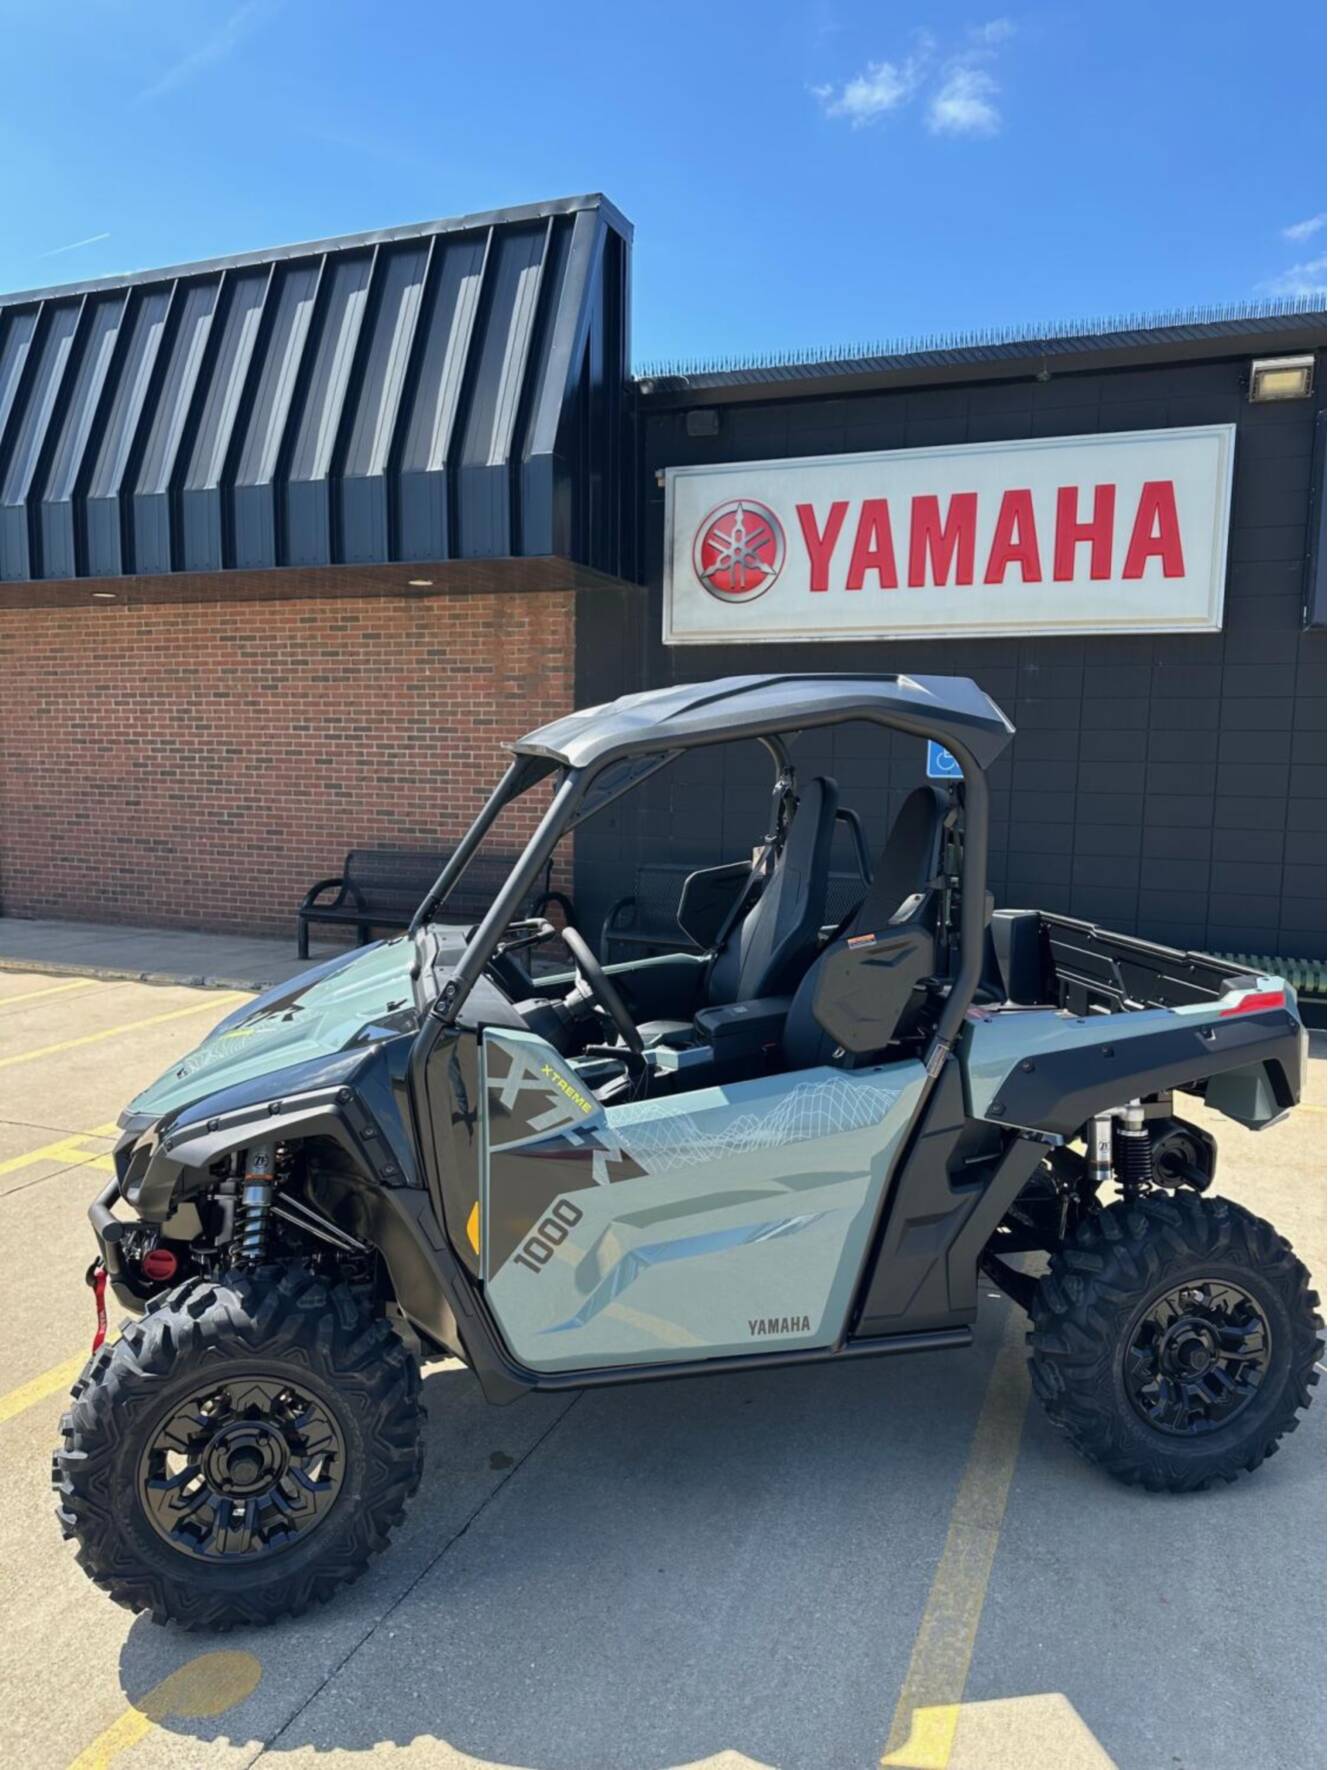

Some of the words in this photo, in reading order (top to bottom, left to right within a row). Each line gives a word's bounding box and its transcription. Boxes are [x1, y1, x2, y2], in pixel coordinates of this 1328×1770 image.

[795, 480, 1186, 592] YAMAHA
[540, 1064, 593, 1114] XTREME
[513, 1199, 583, 1274] 1000
[748, 1315, 811, 1336] YAMAHA
